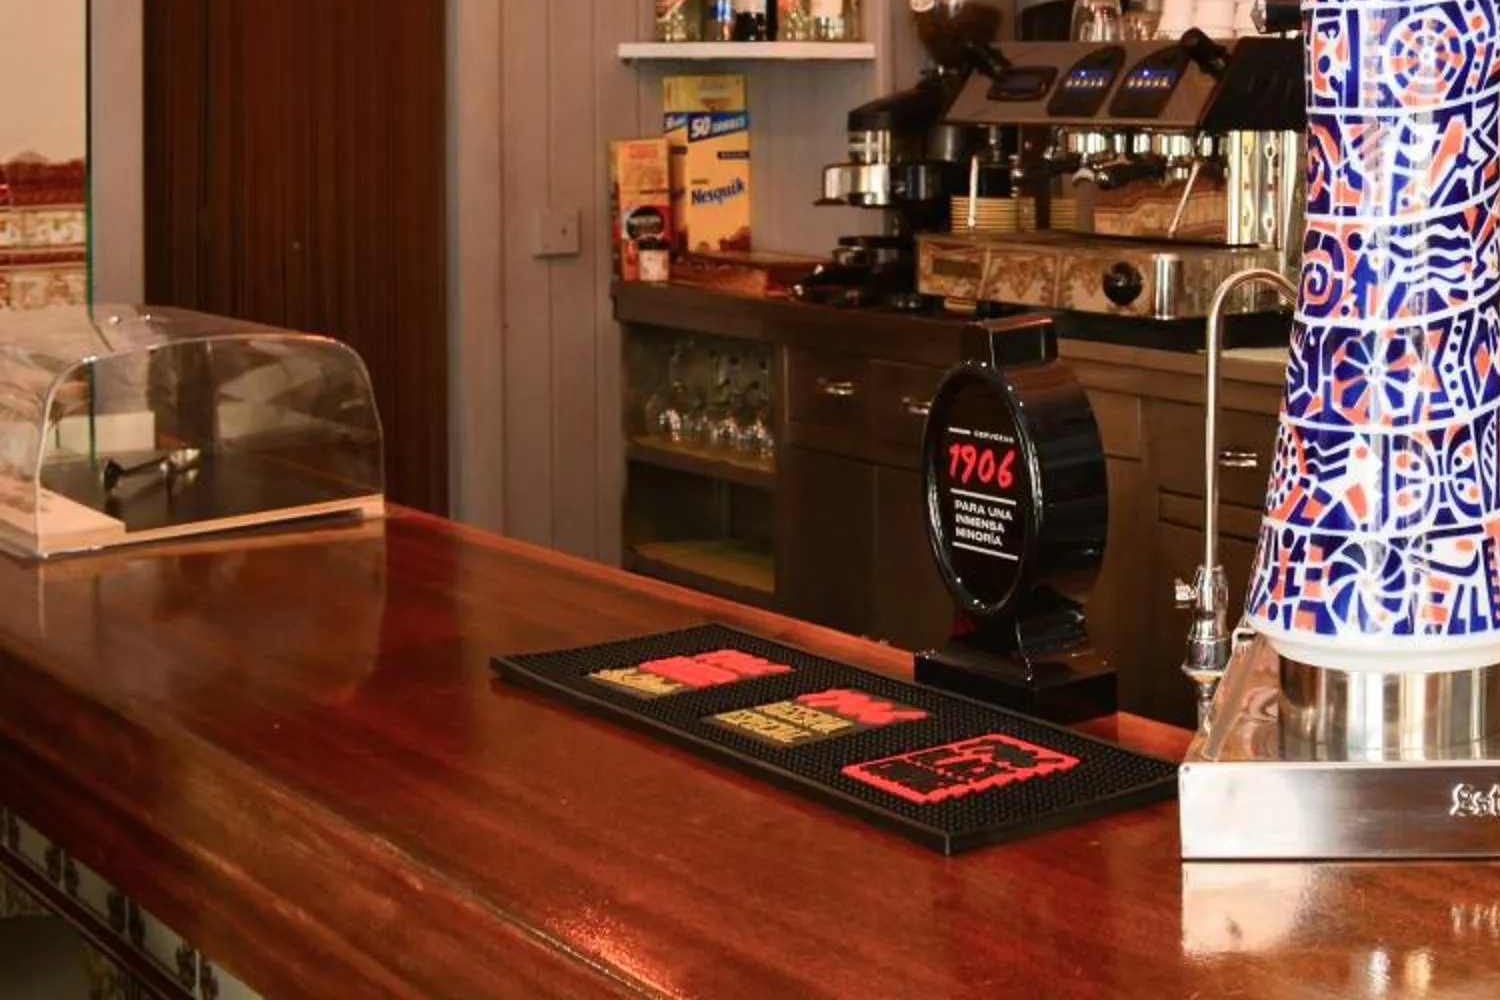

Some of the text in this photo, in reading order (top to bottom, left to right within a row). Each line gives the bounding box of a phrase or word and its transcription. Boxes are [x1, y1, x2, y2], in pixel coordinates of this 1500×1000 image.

[691, 116, 711, 138] 50
[691, 177, 746, 206] Nesquik
[949, 442, 1016, 489] 1906
[954, 499, 1013, 521] PARA UNA
[955, 513, 1006, 534] INMENSA
